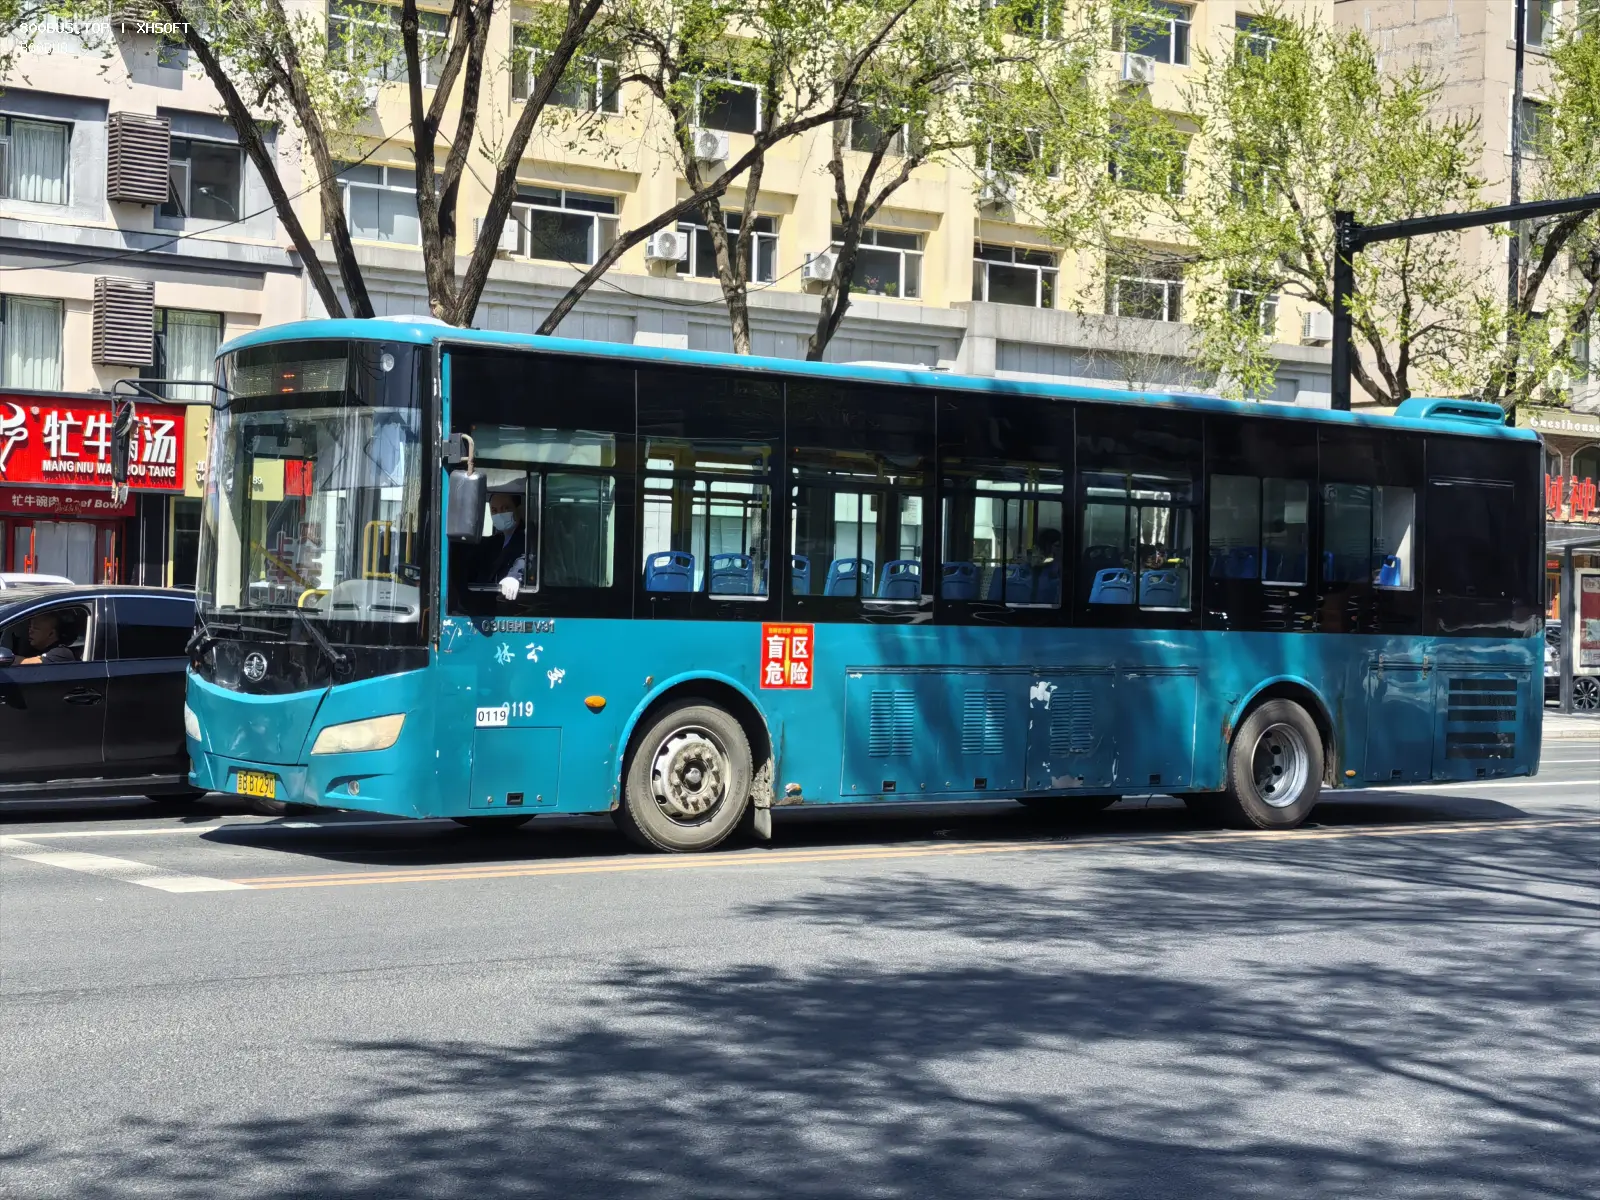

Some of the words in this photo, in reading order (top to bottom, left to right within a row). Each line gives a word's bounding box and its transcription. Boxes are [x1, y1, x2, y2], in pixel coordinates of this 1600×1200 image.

[42, 460, 74, 472] MANG
[76, 462, 94, 473] NIU
[96, 462, 112, 475] WA
[127, 464, 146, 476] OU
[148, 465, 176, 477] TANG
[766, 634, 809, 659] 盲区
[765, 660, 808, 685] 危险
[477, 710, 507, 722] 0119
